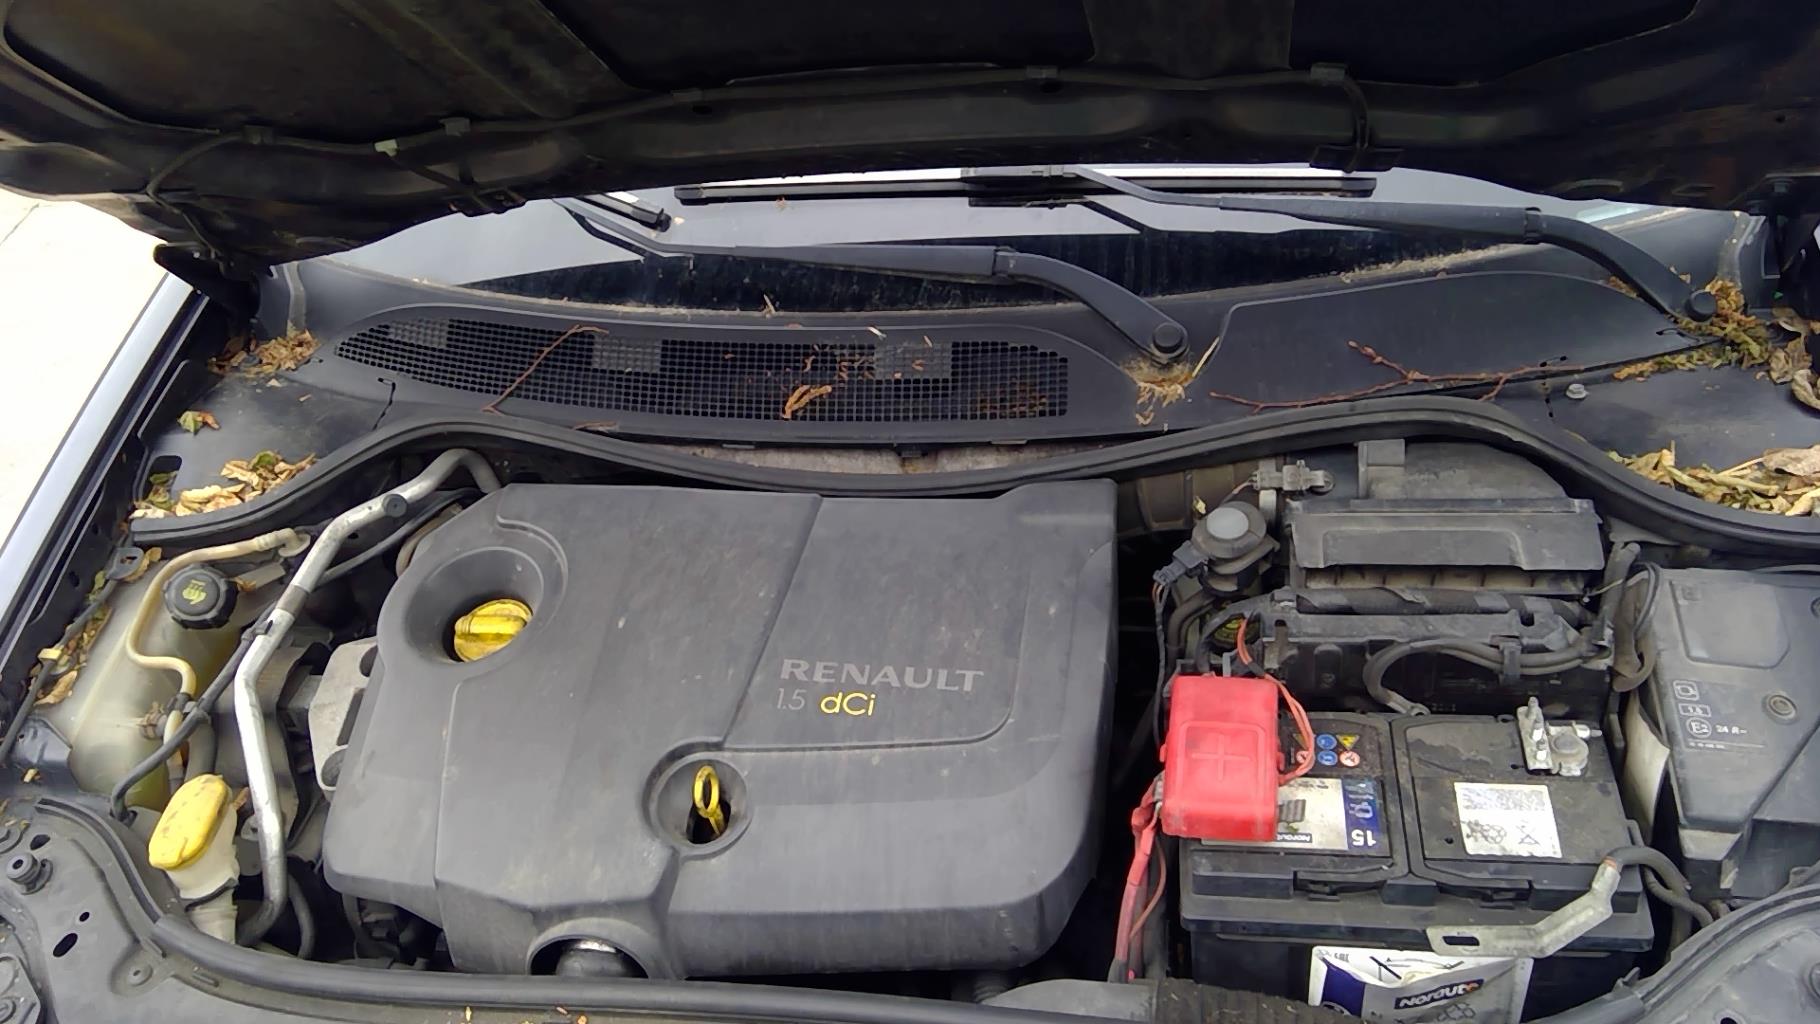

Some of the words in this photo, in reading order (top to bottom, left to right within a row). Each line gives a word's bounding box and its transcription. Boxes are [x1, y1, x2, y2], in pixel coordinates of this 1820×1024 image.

[780, 658, 985, 692] RENAULT
[777, 687, 807, 711] 1.5
[819, 691, 877, 716] dCi
[1351, 828, 1377, 847] 15
